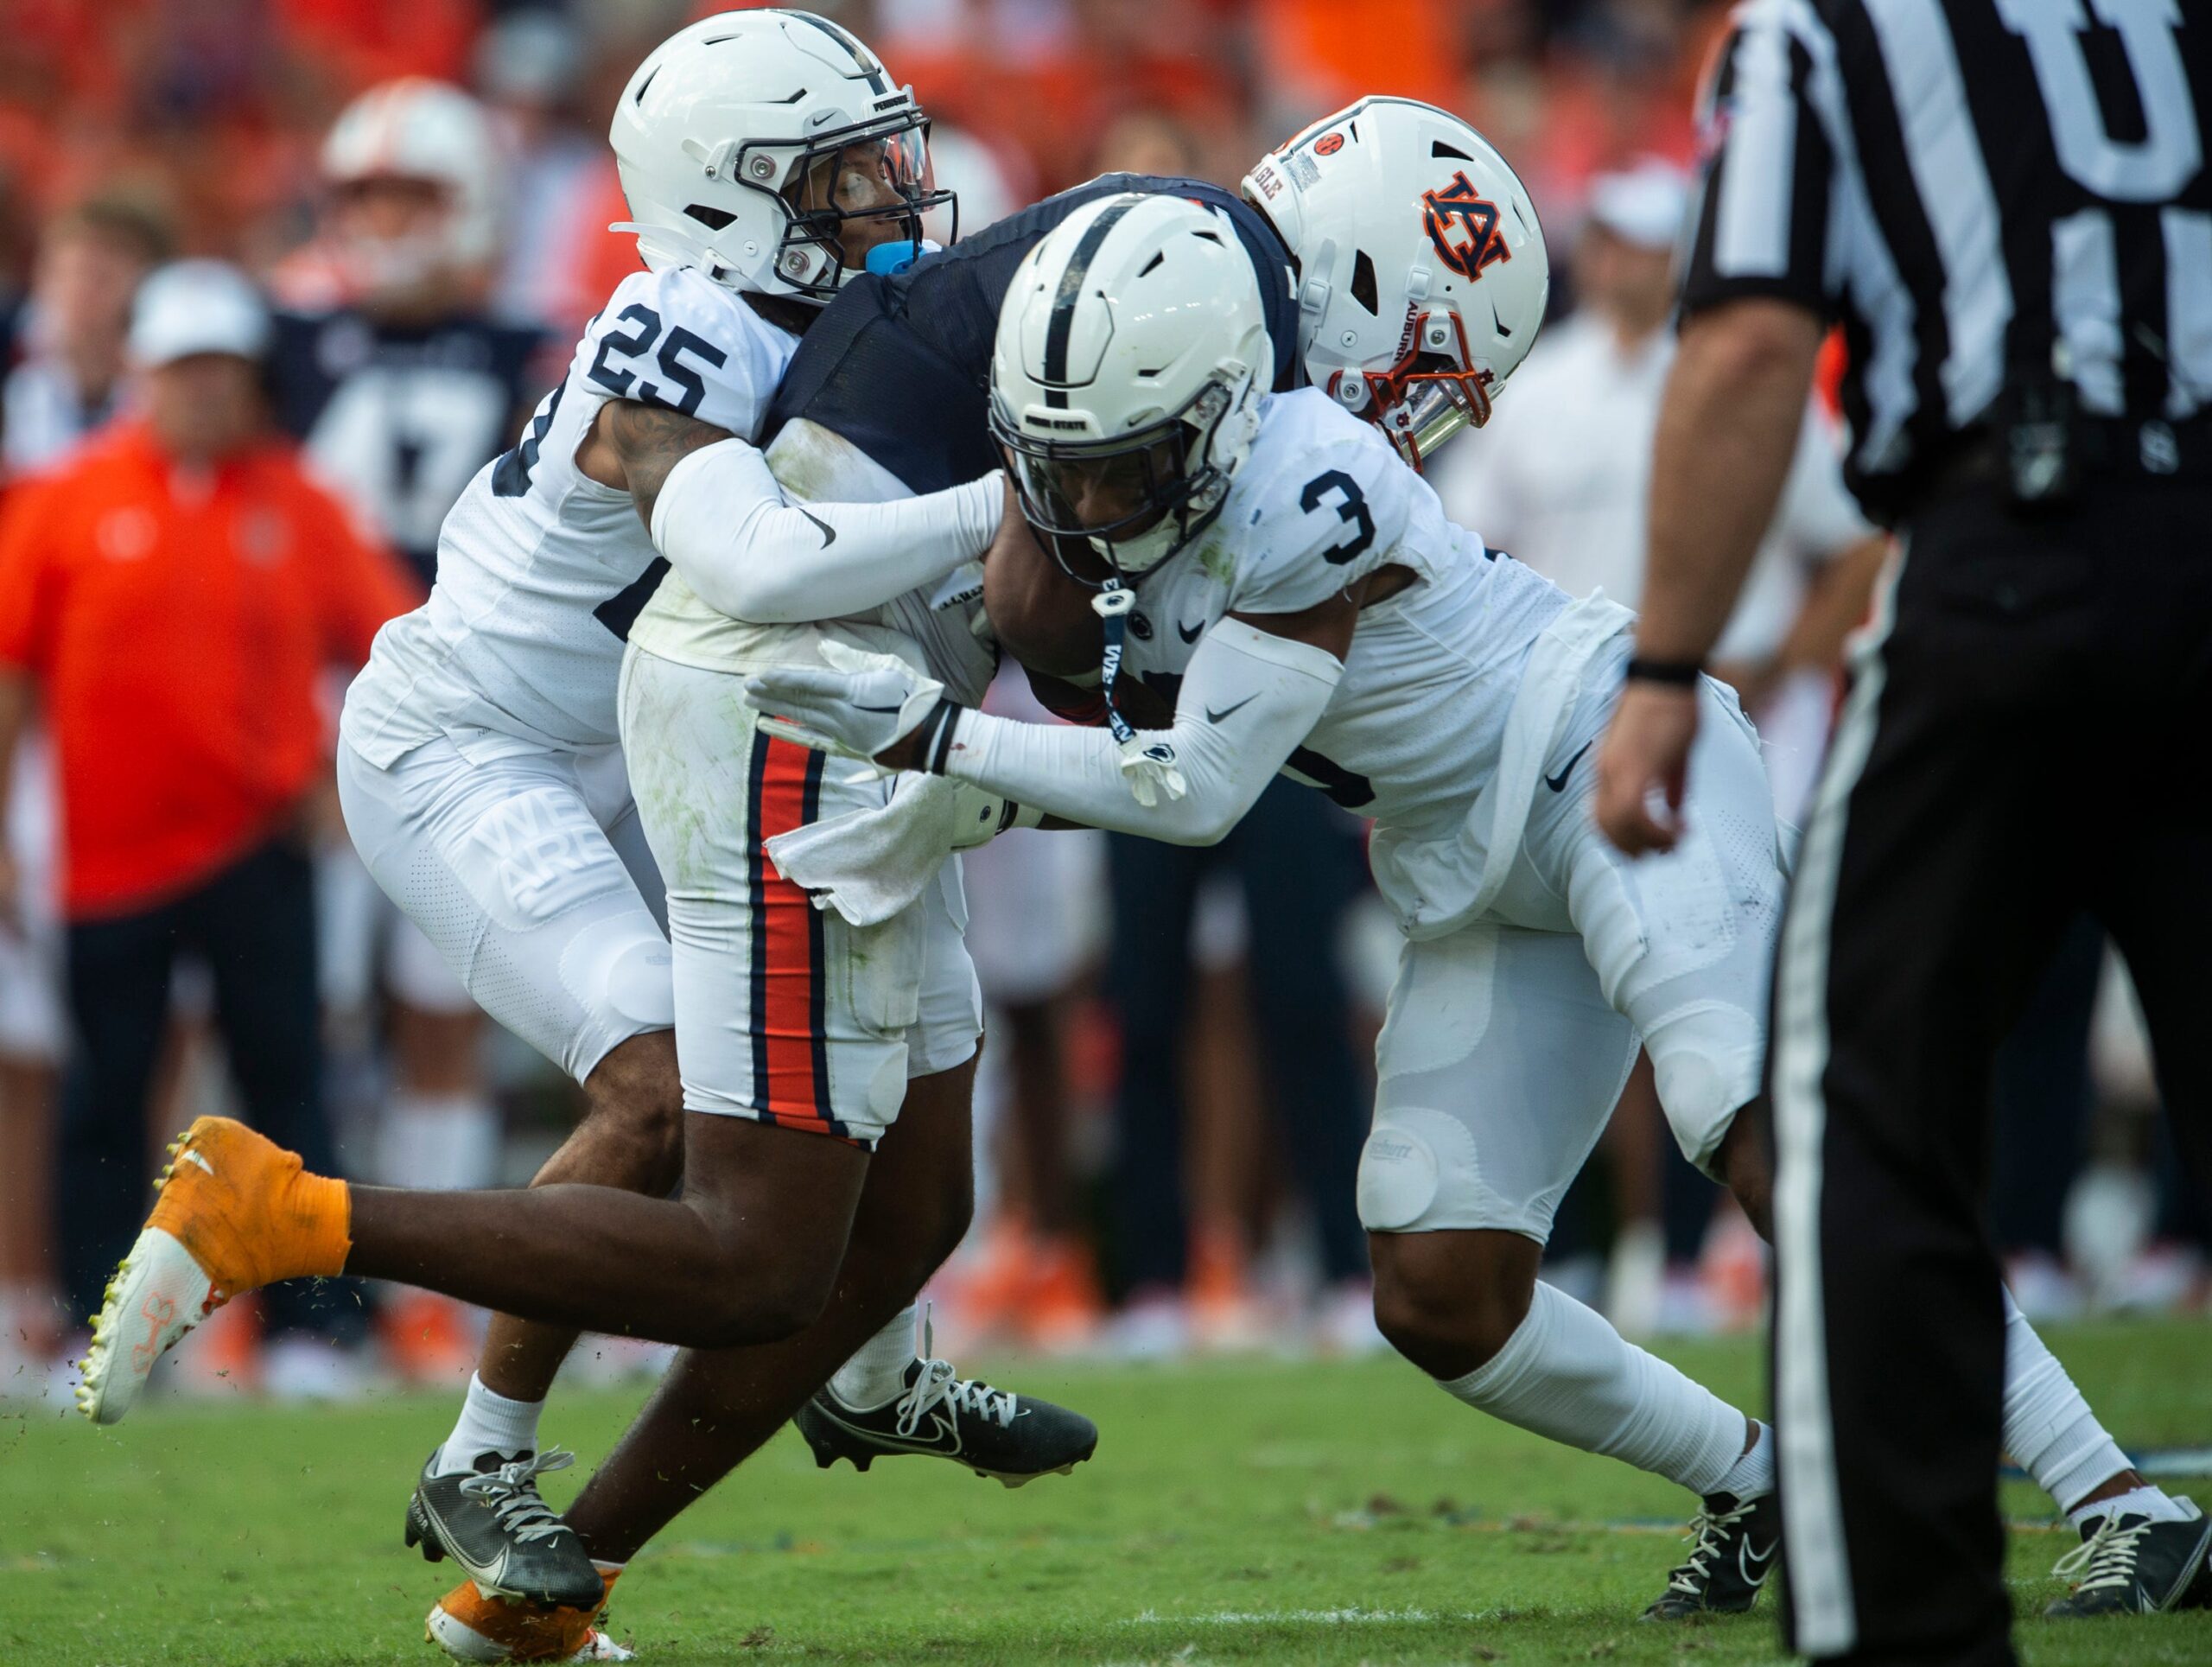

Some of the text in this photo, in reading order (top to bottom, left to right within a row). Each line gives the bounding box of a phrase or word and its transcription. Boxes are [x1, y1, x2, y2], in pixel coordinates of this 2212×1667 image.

[1993, 0, 2203, 202] U
[588, 303, 728, 417] 25
[1394, 300, 1419, 362] AUBURN
[1300, 469, 1368, 565] 3
[473, 787, 591, 862] WE
[496, 827, 619, 913] ARE
